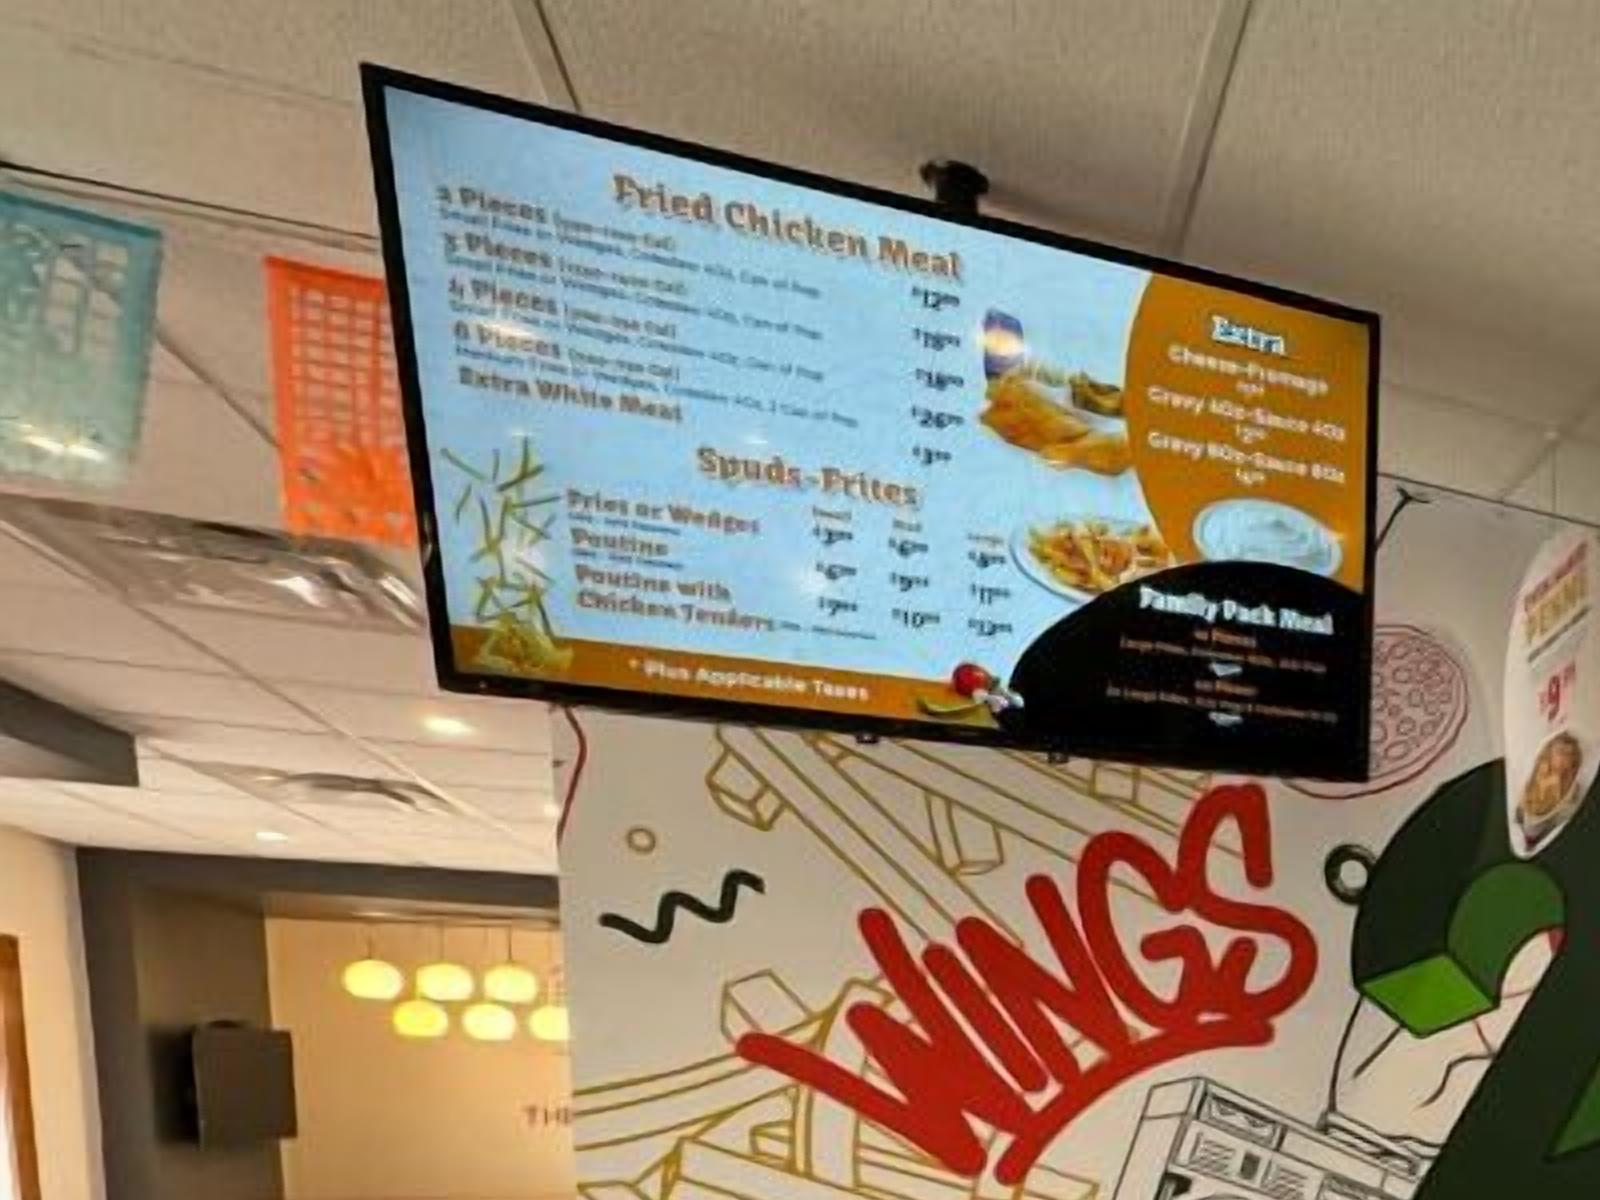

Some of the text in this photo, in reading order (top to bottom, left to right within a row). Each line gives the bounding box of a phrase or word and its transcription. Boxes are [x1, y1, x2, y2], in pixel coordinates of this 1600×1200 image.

[614, 175, 713, 224] Fried
[725, 202, 868, 257] Chicken
[879, 236, 963, 280] Meal
[460, 367, 529, 395] Extra
[536, 380, 612, 408] White
[567, 488, 628, 515] Fries
[570, 527, 669, 557] Poutine
[575, 563, 671, 592] Poutine
[577, 591, 677, 618] Chicken
[680, 603, 774, 632] Tenders
[696, 667, 807, 693] Applicable
[736, 783, 1320, 1184] WINGS
